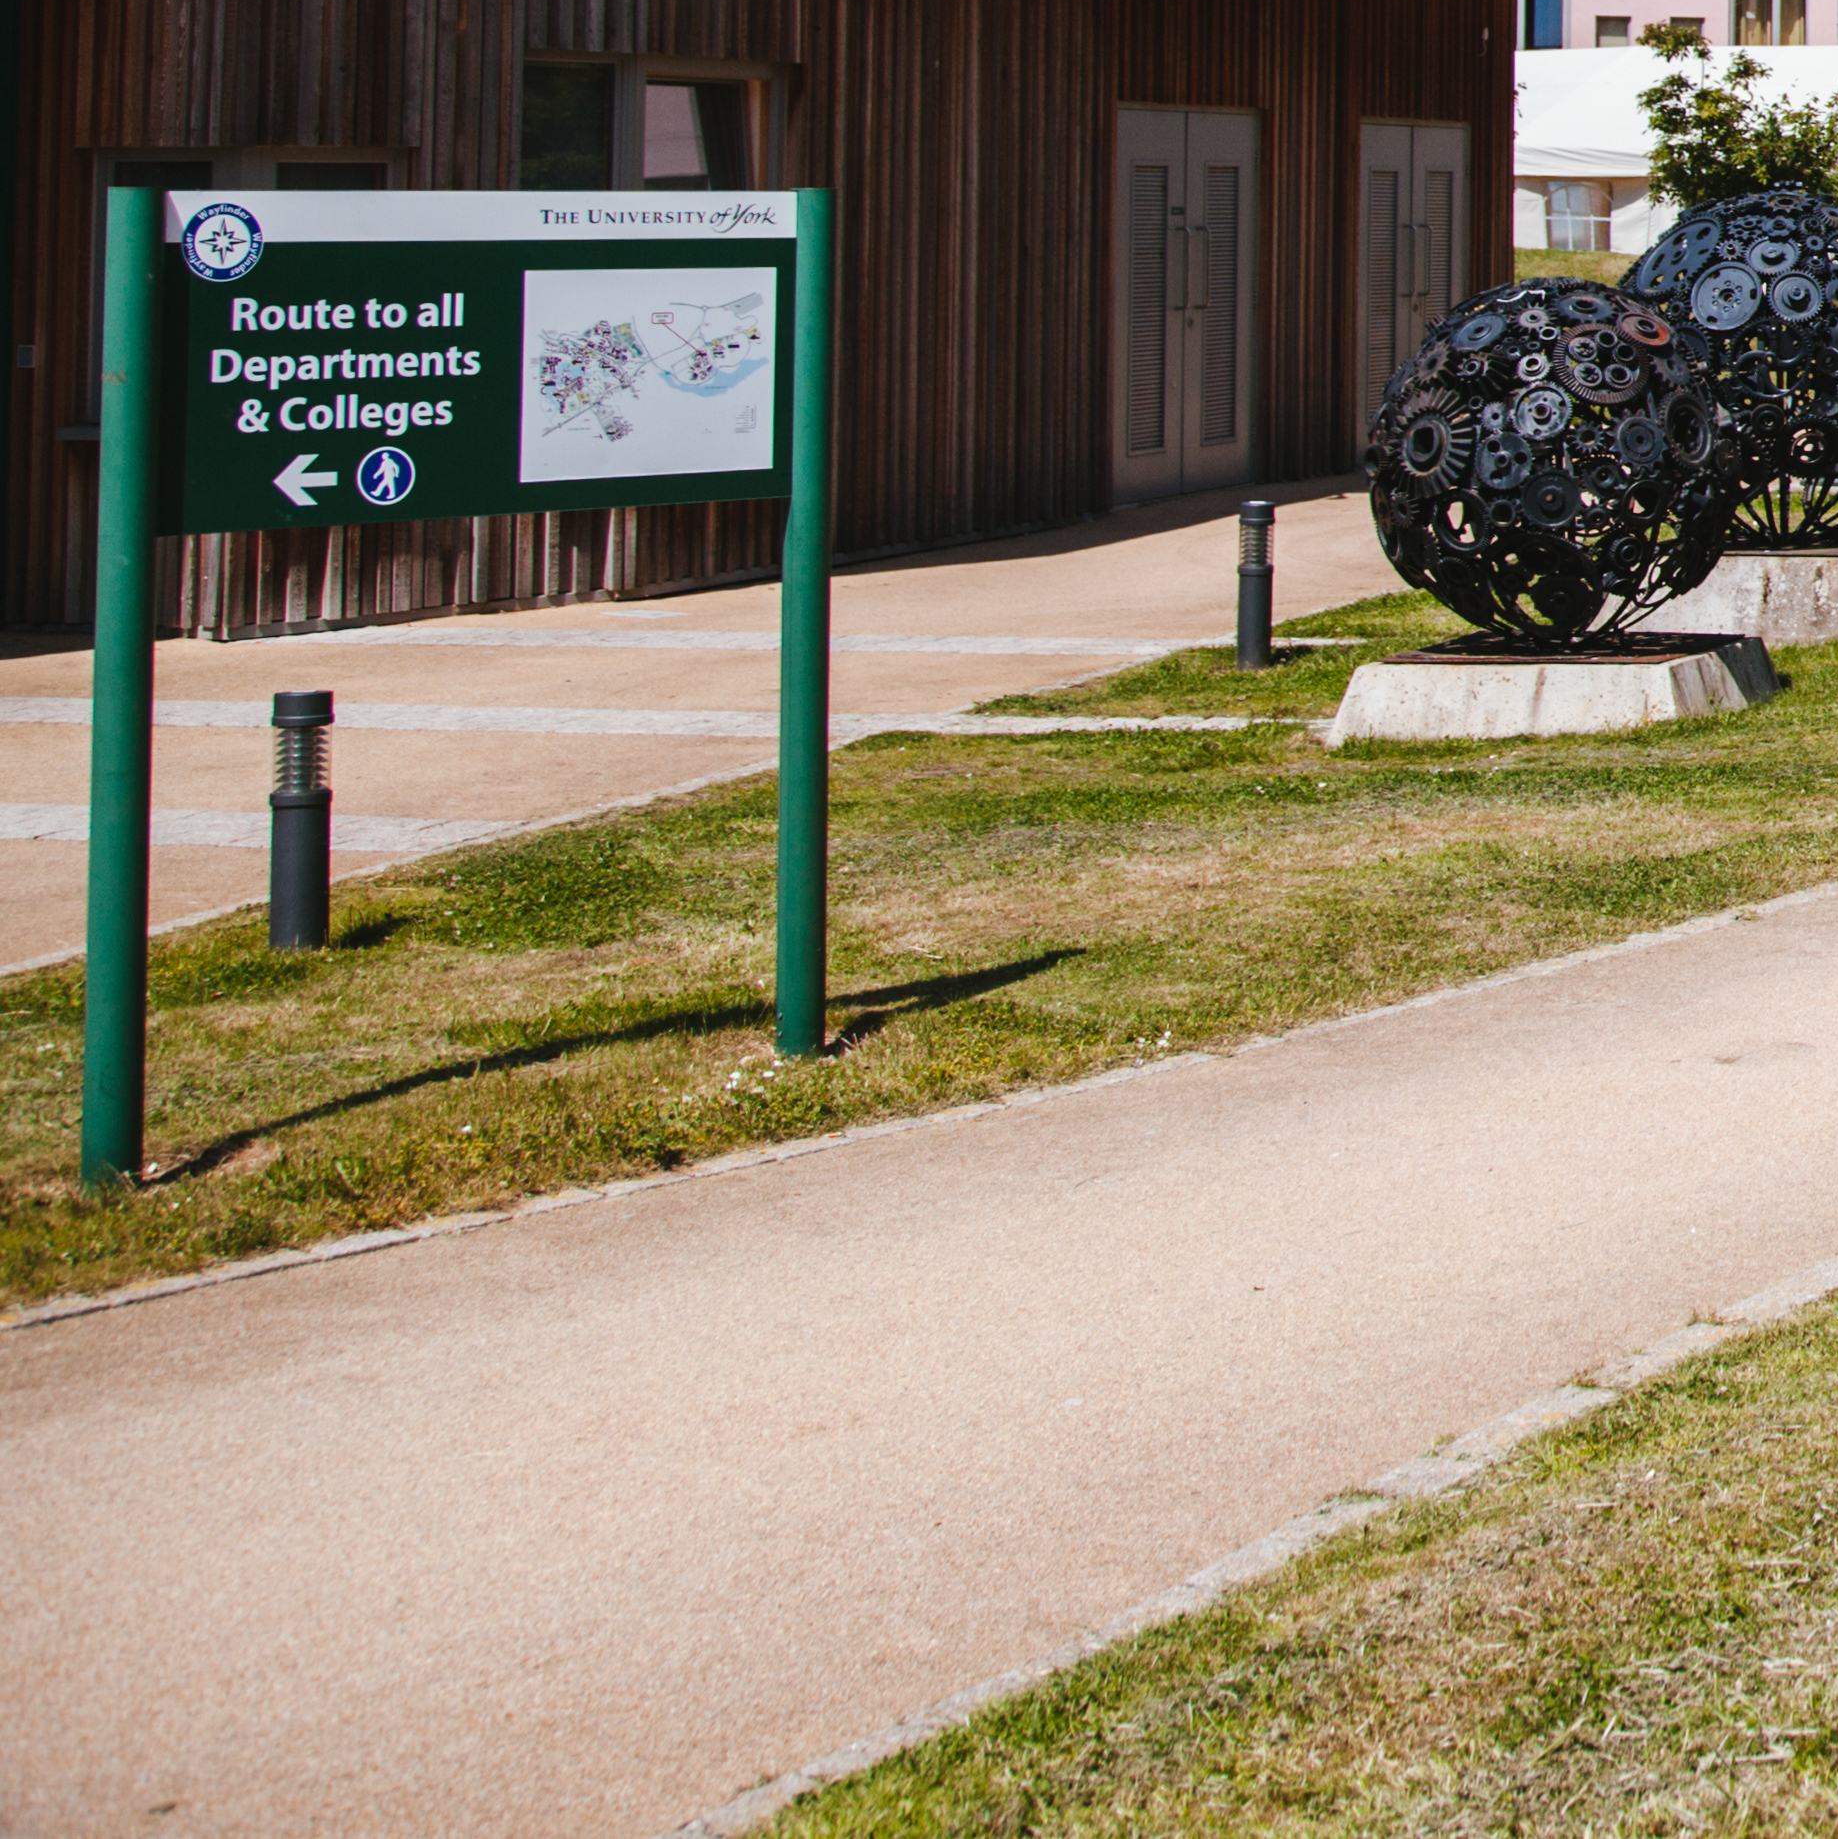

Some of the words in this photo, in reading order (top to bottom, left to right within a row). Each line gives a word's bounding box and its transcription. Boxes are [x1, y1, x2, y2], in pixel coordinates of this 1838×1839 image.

[197, 204, 250, 220] Wayfinder
[540, 209, 580, 224] THE
[588, 209, 706, 224] UNIVERSITY
[709, 207, 735, 226] of
[713, 203, 778, 234] York
[185, 232, 214, 277] Wayfinder
[229, 232, 262, 276] Wayfinder
[231, 297, 356, 331] Route
[364, 298, 408, 329] to
[416, 292, 465, 327] all
[210, 346, 481, 390] Departments
[236, 398, 270, 433] &
[278, 393, 454, 436] Colleges
